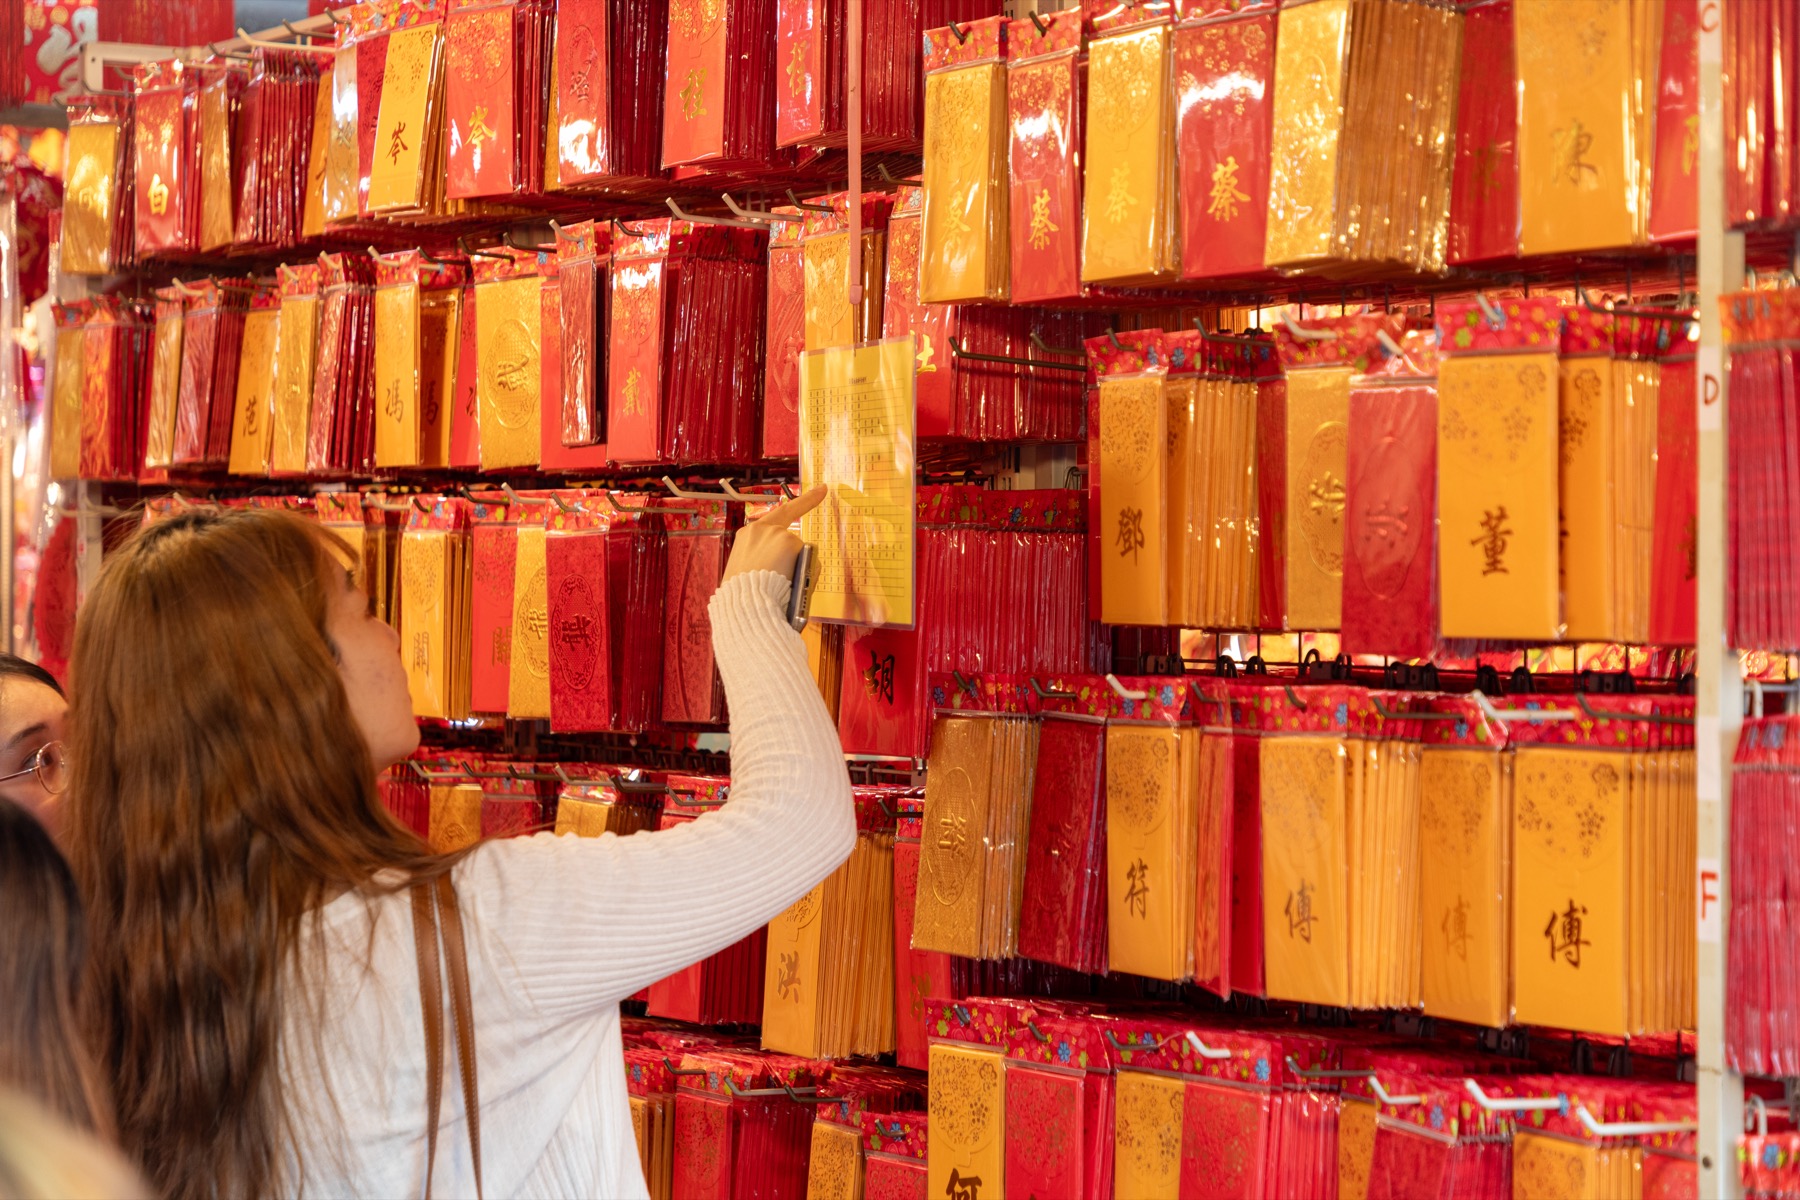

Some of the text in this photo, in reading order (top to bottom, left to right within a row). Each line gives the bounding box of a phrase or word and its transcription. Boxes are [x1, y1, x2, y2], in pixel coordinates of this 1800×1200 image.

[1701, 2, 1719, 33] C
[680, 68, 708, 121] 程
[386, 121, 408, 166] 岑
[147, 173, 169, 216] 白
[1104, 162, 1138, 223] 蔡
[1207, 156, 1251, 222] 蔡
[1028, 188, 1059, 250] 蔡
[622, 367, 644, 416] 戴
[1704, 374, 1720, 406] D
[1115, 506, 1145, 567] 鄧
[1470, 505, 1514, 577] 董
[862, 650, 895, 706] 胡
[1124, 857, 1150, 920] 符
[1284, 878, 1319, 944] 傅
[1701, 871, 1717, 919] F
[1441, 893, 1474, 962] 傅
[1543, 898, 1592, 970] 傅
[777, 950, 802, 1004] 洪
